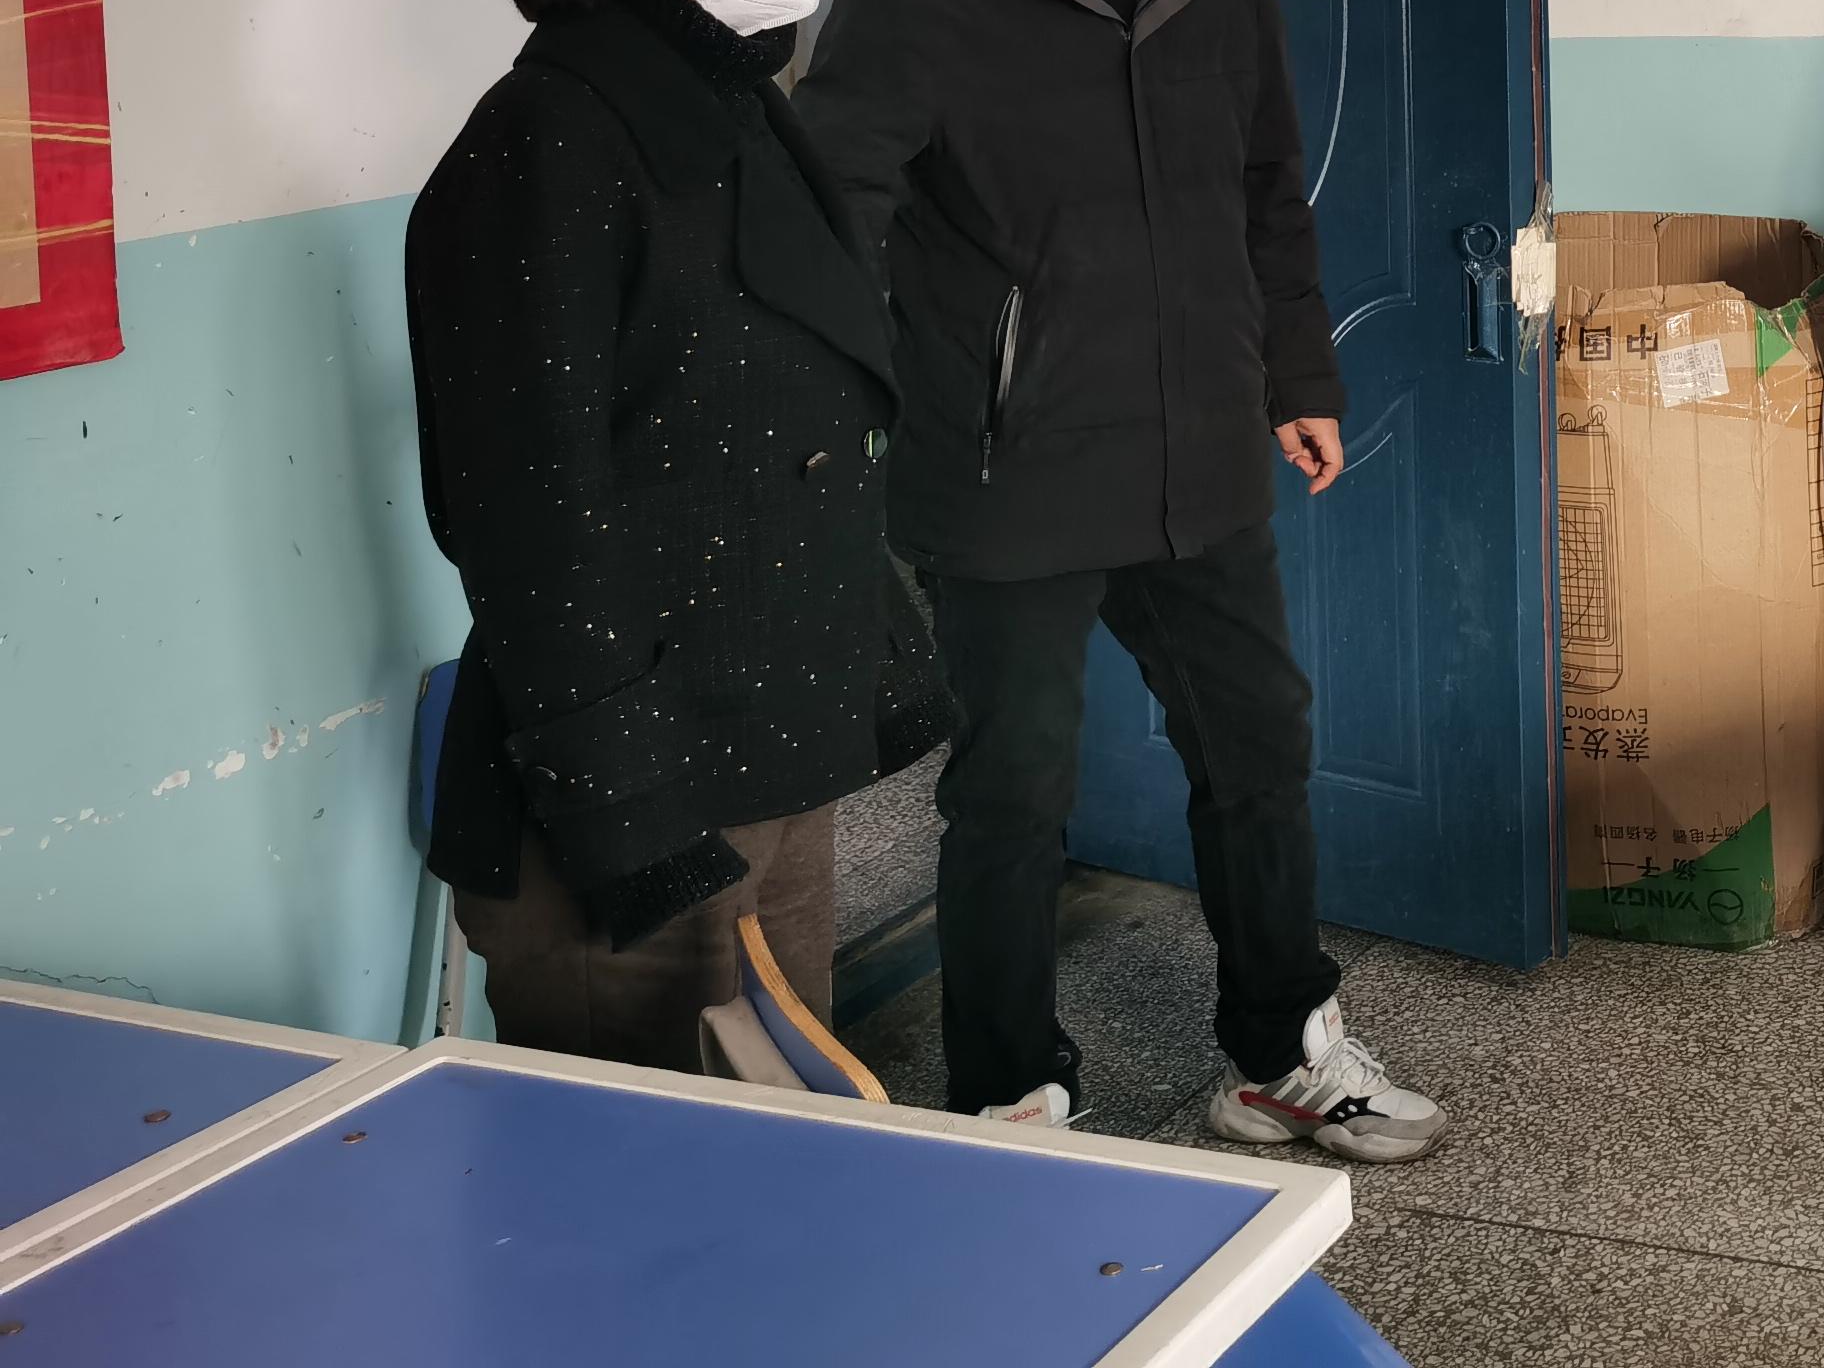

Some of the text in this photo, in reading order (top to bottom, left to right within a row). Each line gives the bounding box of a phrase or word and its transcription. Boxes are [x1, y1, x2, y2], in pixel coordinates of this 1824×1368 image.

[1562, 705, 1648, 725] Evapora
[1637, 857, 1697, 882] 扬子
[1004, 1107, 1043, 1123] didas
